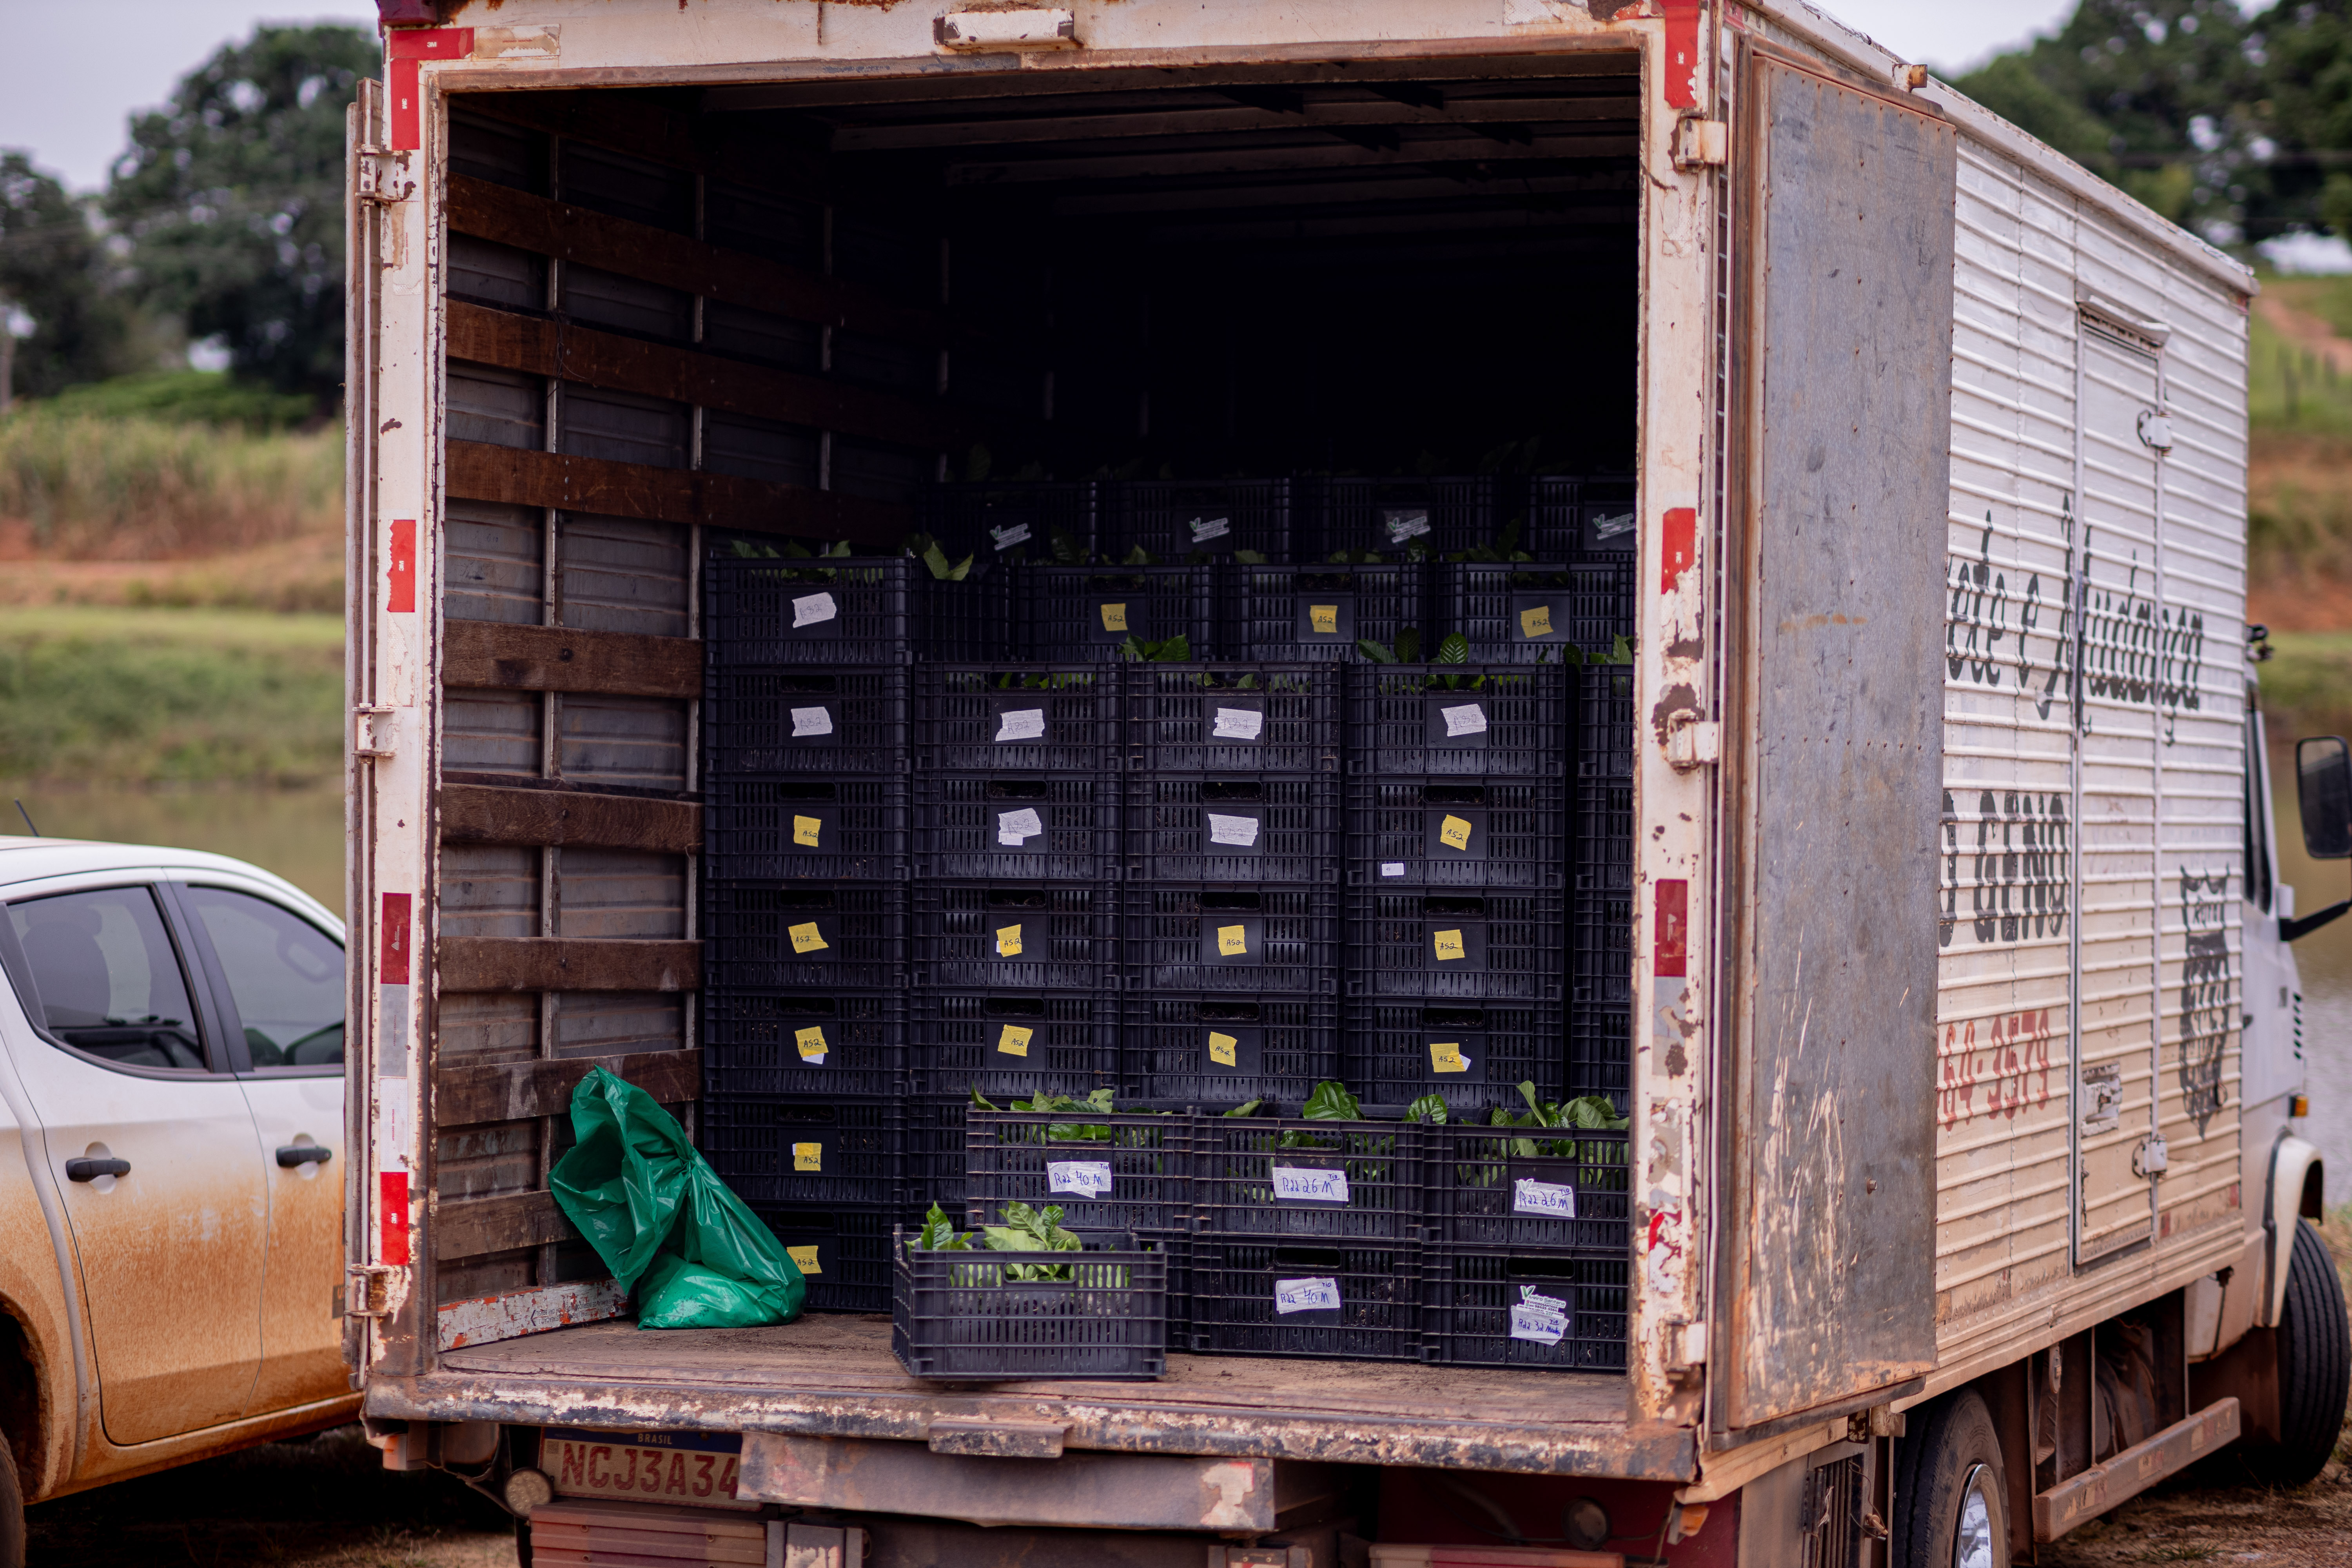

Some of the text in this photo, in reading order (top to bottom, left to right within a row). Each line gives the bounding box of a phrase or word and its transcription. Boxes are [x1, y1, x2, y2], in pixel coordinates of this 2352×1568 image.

[1678, 52, 1684, 65] 3M
[402, 98, 407, 109] 3M
[1675, 551, 1682, 564] 3M
[398, 560, 404, 571] 3M
[1947, 509, 2007, 687] ete
[1532, 618, 1548, 626] AS2
[1446, 829, 1464, 842] AS2
[1004, 938, 1021, 947] AS2
[804, 1039, 822, 1047] AS2
[1011, 1038, 1024, 1047] AS2
[1215, 1046, 1230, 1056] AS2
[1076, 1170, 1089, 1186] 40
[1093, 1174, 1103, 1186] M
[1302, 1177, 1318, 1193] 26
[1322, 1180, 1334, 1196] M
[1540, 1191, 1556, 1207] 26
[1558, 1199, 1568, 1210] M
[391, 1212, 397, 1224] 3M
[1303, 1287, 1318, 1305] 40
[1321, 1292, 1330, 1304] M
[1544, 1298, 1565, 1306] Santana
[1530, 1301, 1558, 1309] VIVEIROSANTANA
[637, 1433, 673, 1445] BRASIL
[561, 1443, 739, 1500] NCJ3A34
